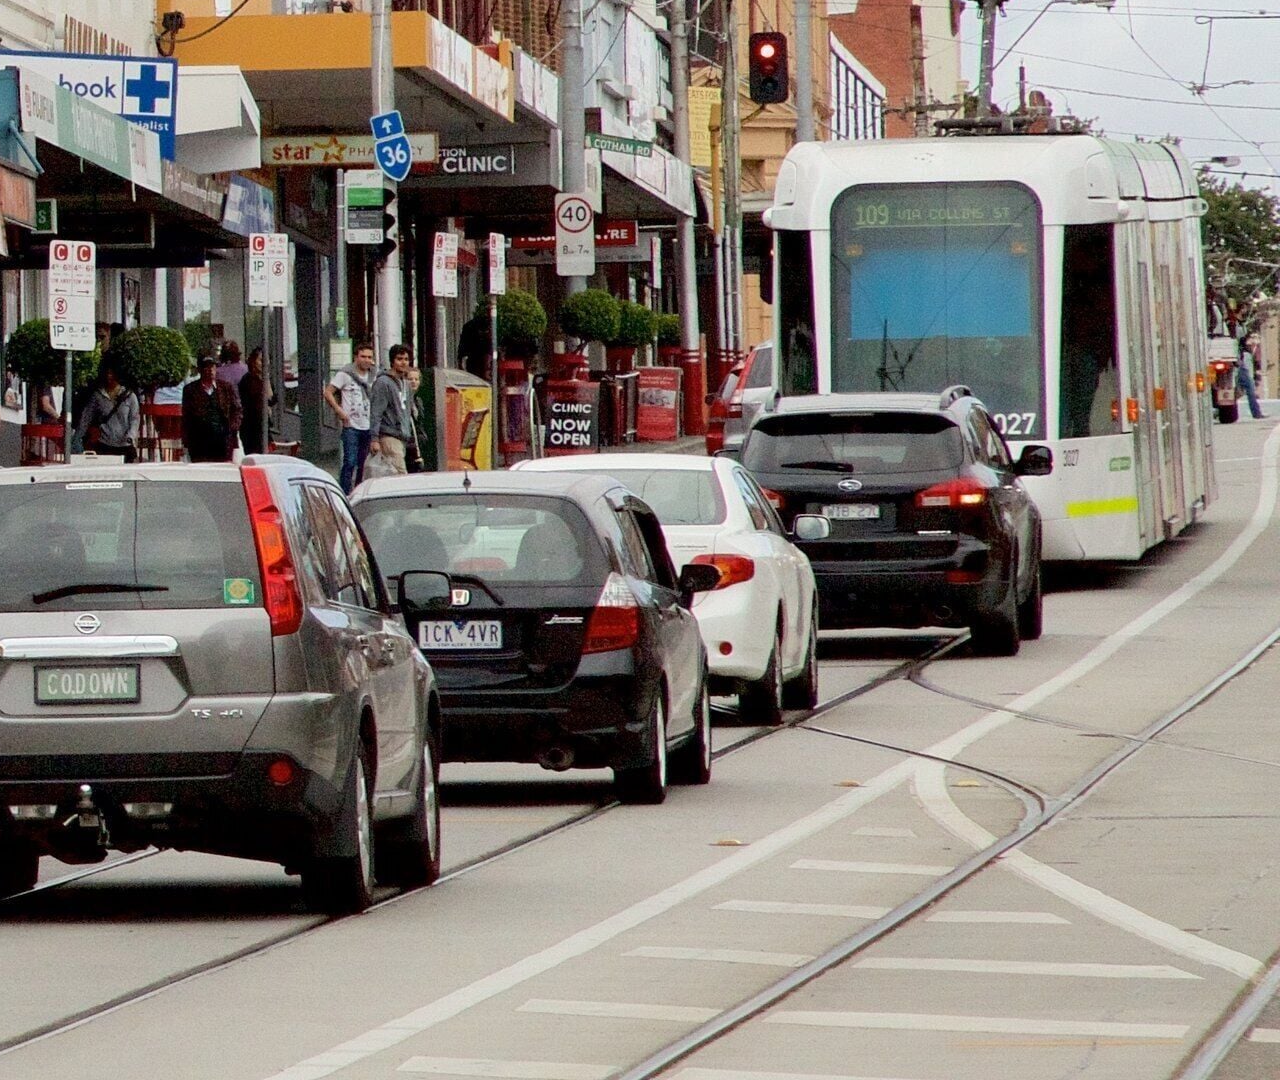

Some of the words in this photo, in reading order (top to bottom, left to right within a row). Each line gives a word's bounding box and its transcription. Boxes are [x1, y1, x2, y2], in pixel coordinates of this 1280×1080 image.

[272, 143, 314, 161] star
[594, 138, 634, 153] COTHAM
[636, 146, 650, 156] RD
[382, 146, 407, 167] 36
[443, 155, 508, 173] CLINIC
[561, 206, 587, 222] 40
[856, 204, 889, 225] 109
[993, 207, 1010, 219] ST
[608, 228, 628, 240] RE
[551, 403, 592, 413] CLINIC
[550, 418, 591, 432] NOW
[550, 433, 591, 446] OPEN
[424, 624, 453, 643] 1CK
[467, 624, 499, 643] 4VR
